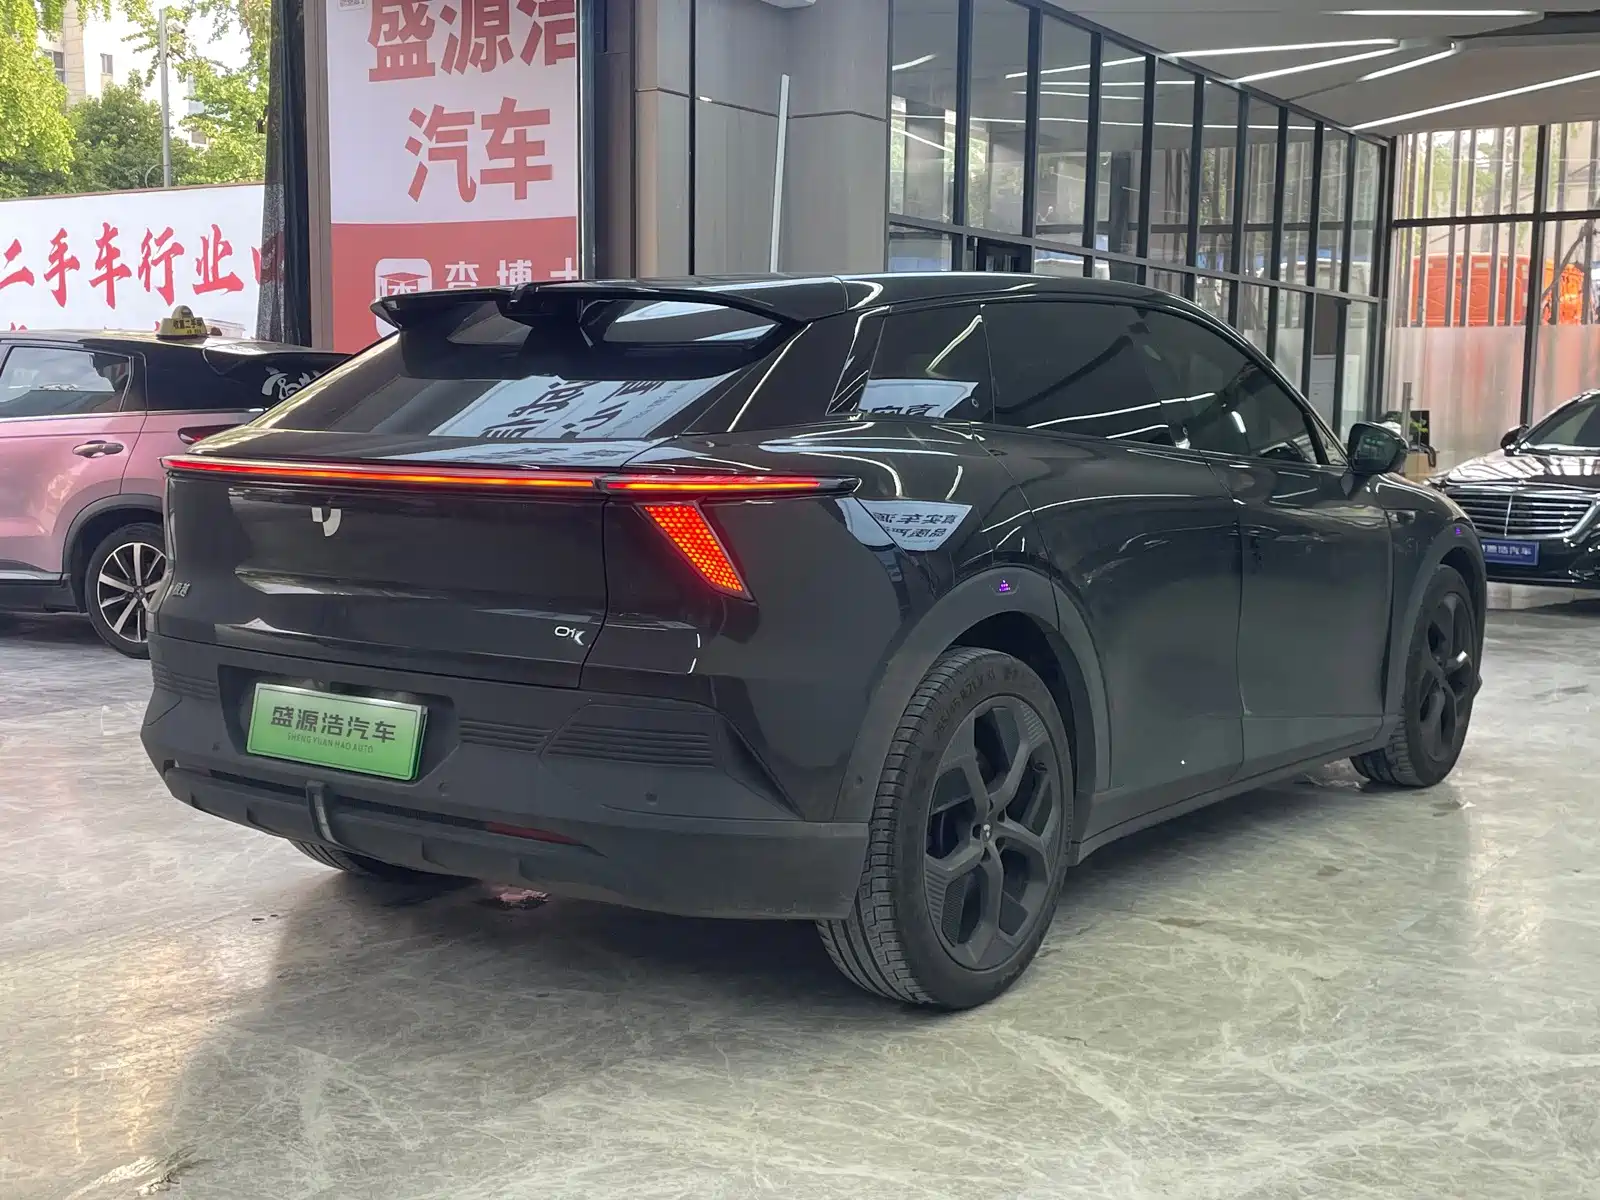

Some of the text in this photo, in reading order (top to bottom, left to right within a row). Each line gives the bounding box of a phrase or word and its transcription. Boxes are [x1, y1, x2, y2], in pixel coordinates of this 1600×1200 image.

[404, 96, 553, 203] 汽车
[271, 705, 397, 744] 盛源浩汽车
[287, 732, 374, 754] SHENG YUAN HAO AUTO
